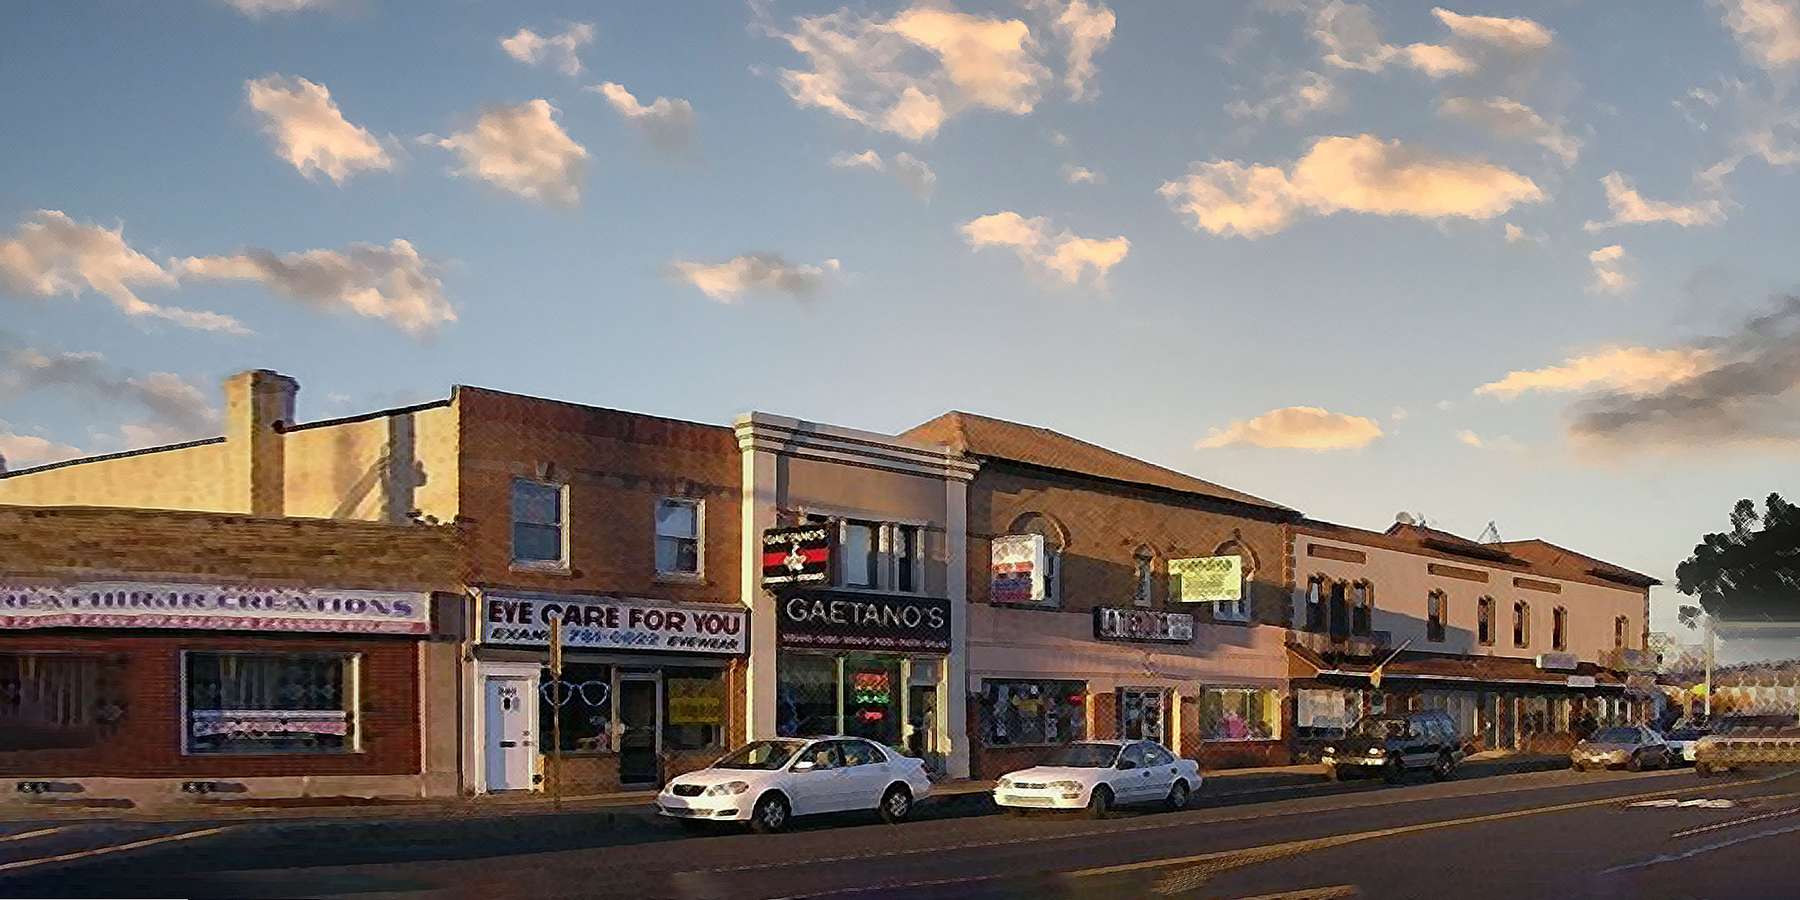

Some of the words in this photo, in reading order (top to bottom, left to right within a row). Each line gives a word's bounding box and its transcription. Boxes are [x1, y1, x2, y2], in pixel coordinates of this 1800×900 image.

[488, 600, 534, 625] EYE
[541, 603, 620, 629] CARE
[628, 608, 688, 633] FOR
[692, 612, 741, 636] YOU
[786, 597, 945, 629] GAETANO'S
